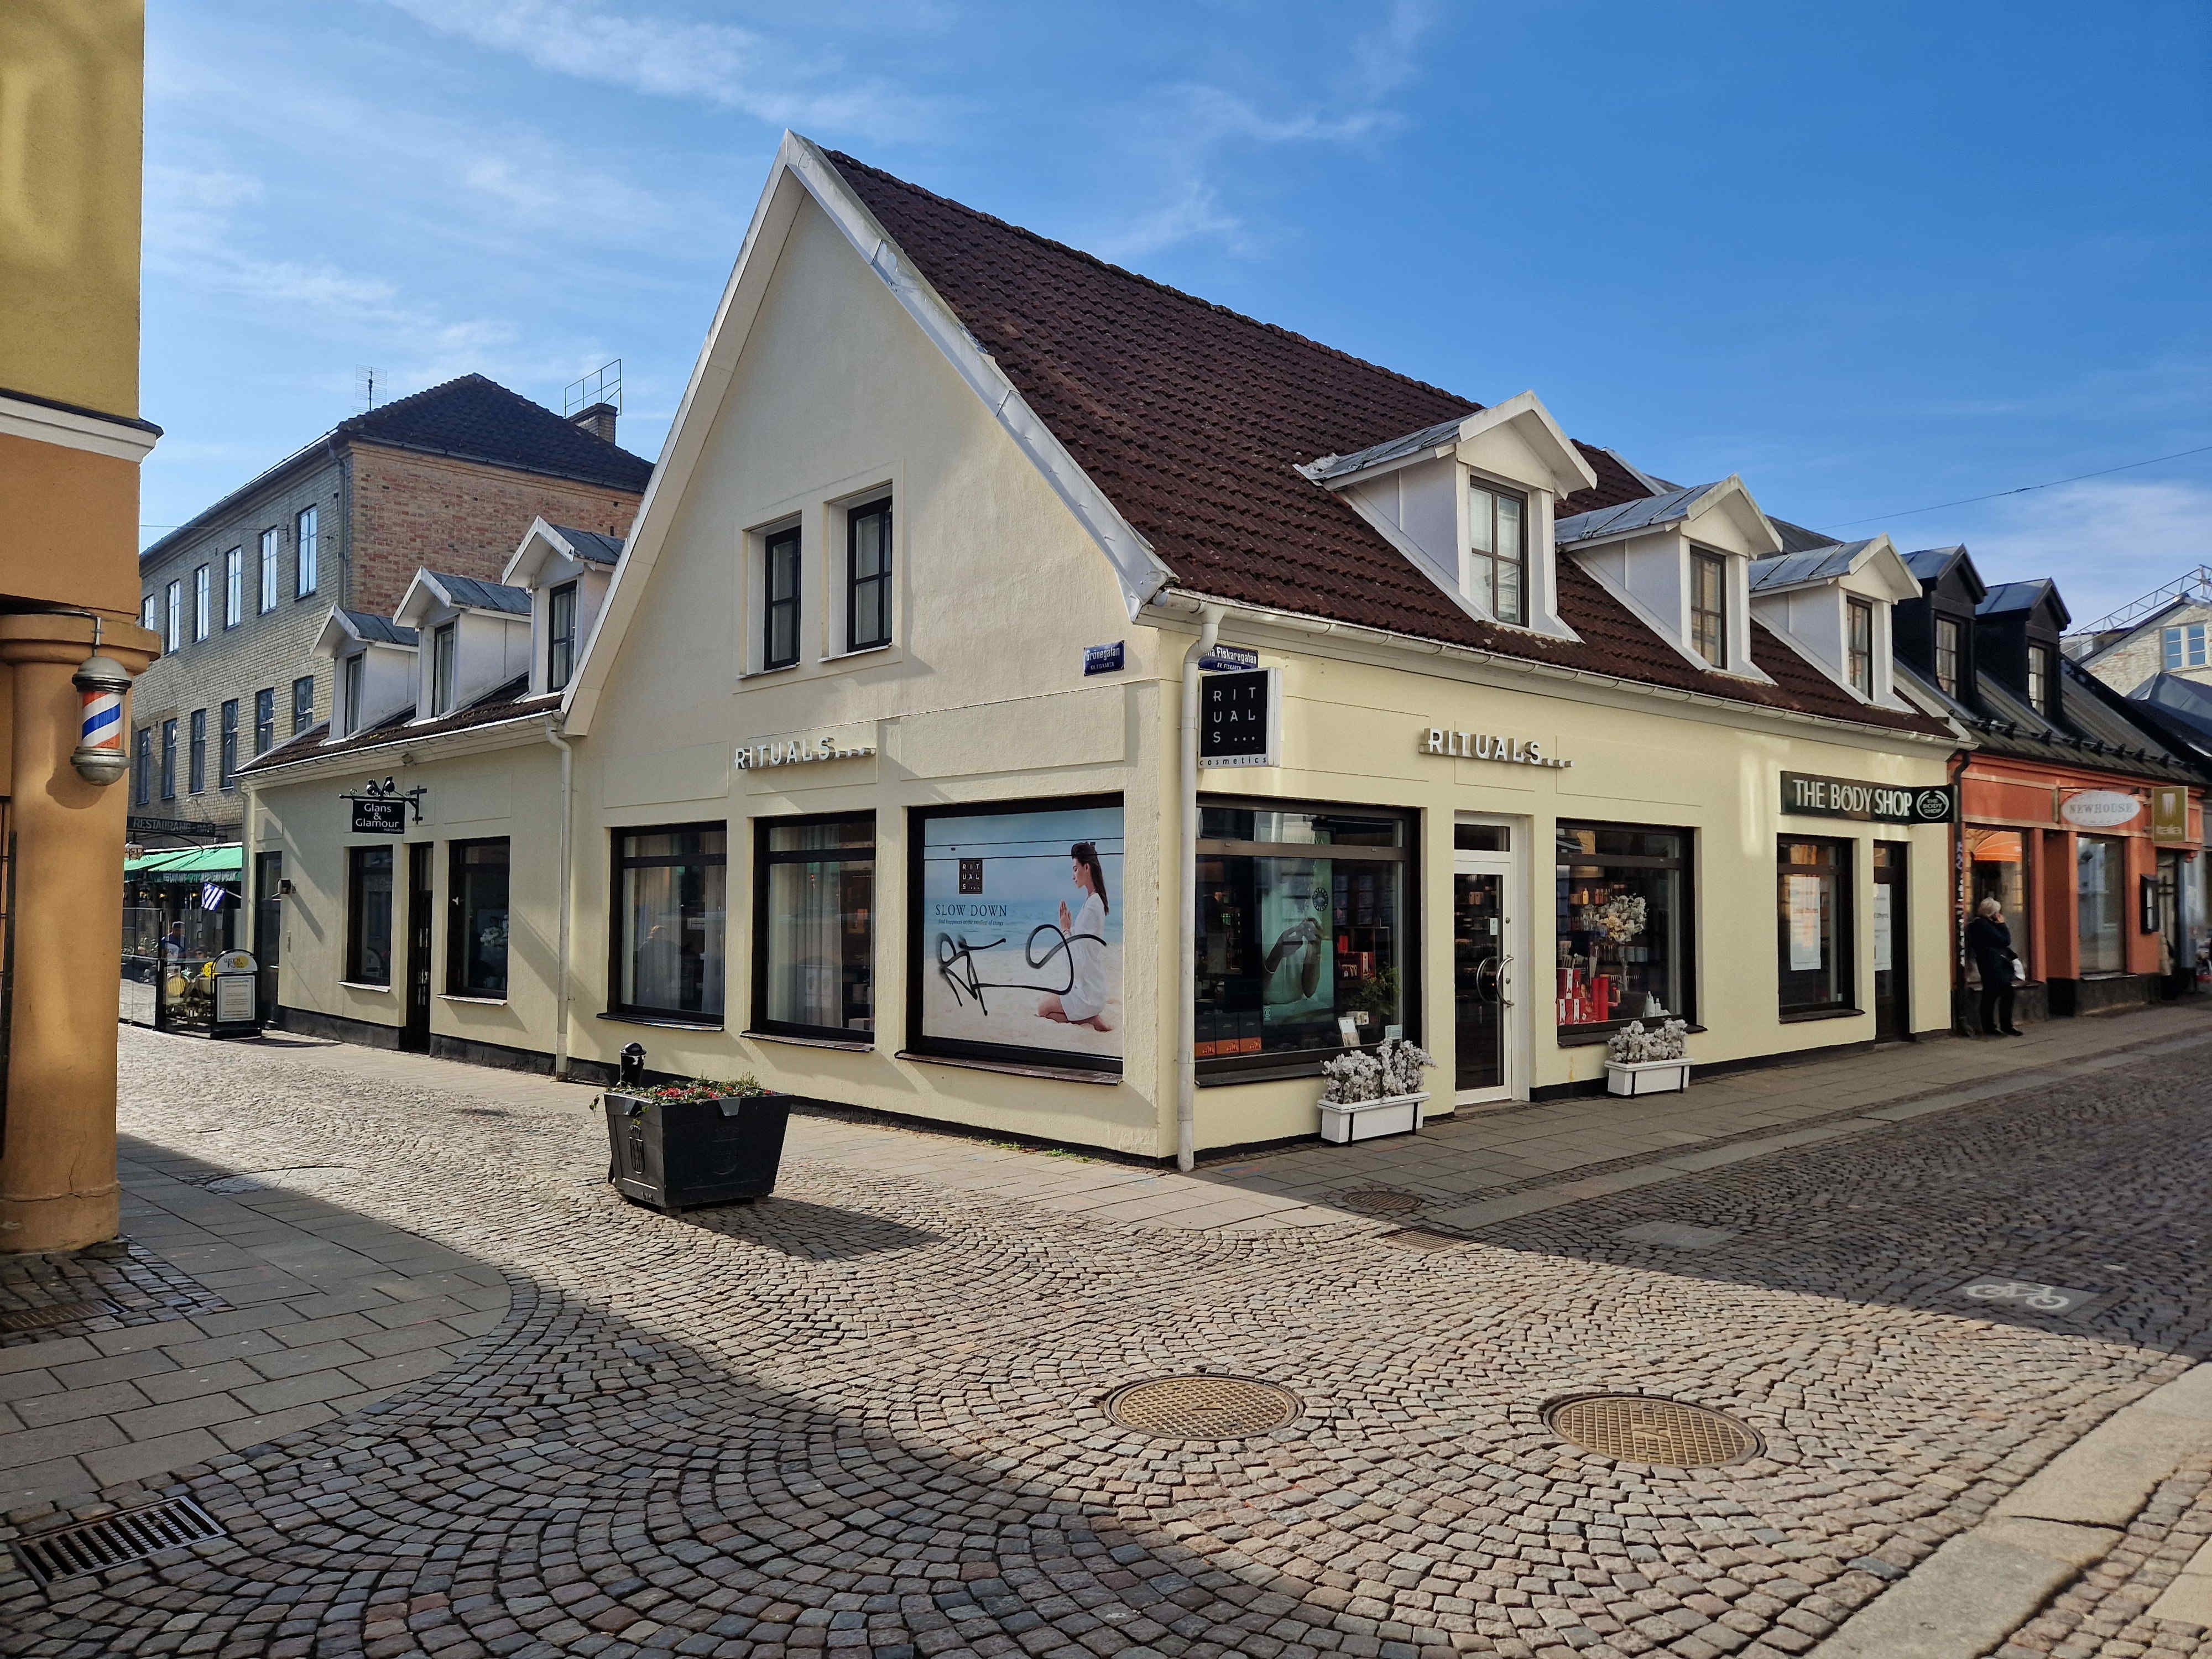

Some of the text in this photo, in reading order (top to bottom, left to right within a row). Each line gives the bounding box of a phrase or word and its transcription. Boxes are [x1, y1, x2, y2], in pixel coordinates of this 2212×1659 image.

[1086, 646, 1120, 661] Grönegatan
[1217, 646, 1257, 664] Fiskaregatan
[1199, 756, 1266, 766] cosmetics
[1793, 780, 1825, 808] THE
[1830, 784, 1872, 812] BODY
[364, 804, 392, 812] Glans
[2070, 803, 2133, 814] NEWHOUSE
[133, 818, 191, 832] RESTAURANG
[356, 818, 399, 827] Glamour
[936, 904, 1007, 916] SLOW DOWN
